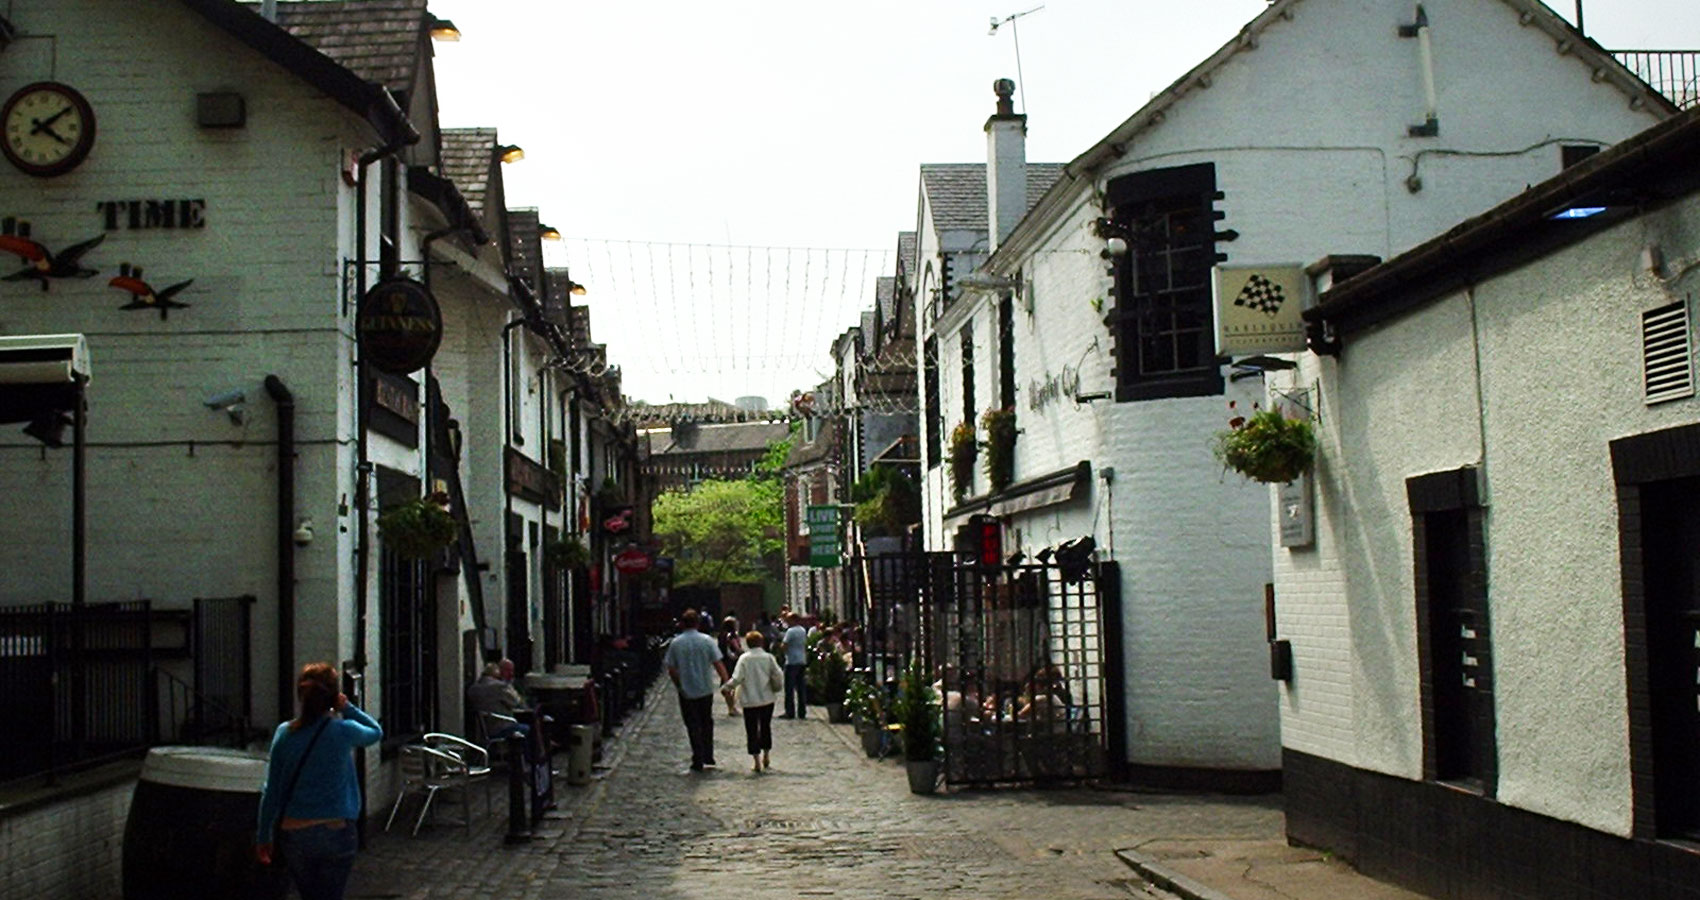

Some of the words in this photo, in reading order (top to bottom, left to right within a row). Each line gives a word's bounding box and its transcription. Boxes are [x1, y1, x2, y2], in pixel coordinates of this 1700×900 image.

[97, 199, 205, 231] TIME
[360, 314, 437, 332] GUINNESS
[809, 508, 836, 522] LIVE
